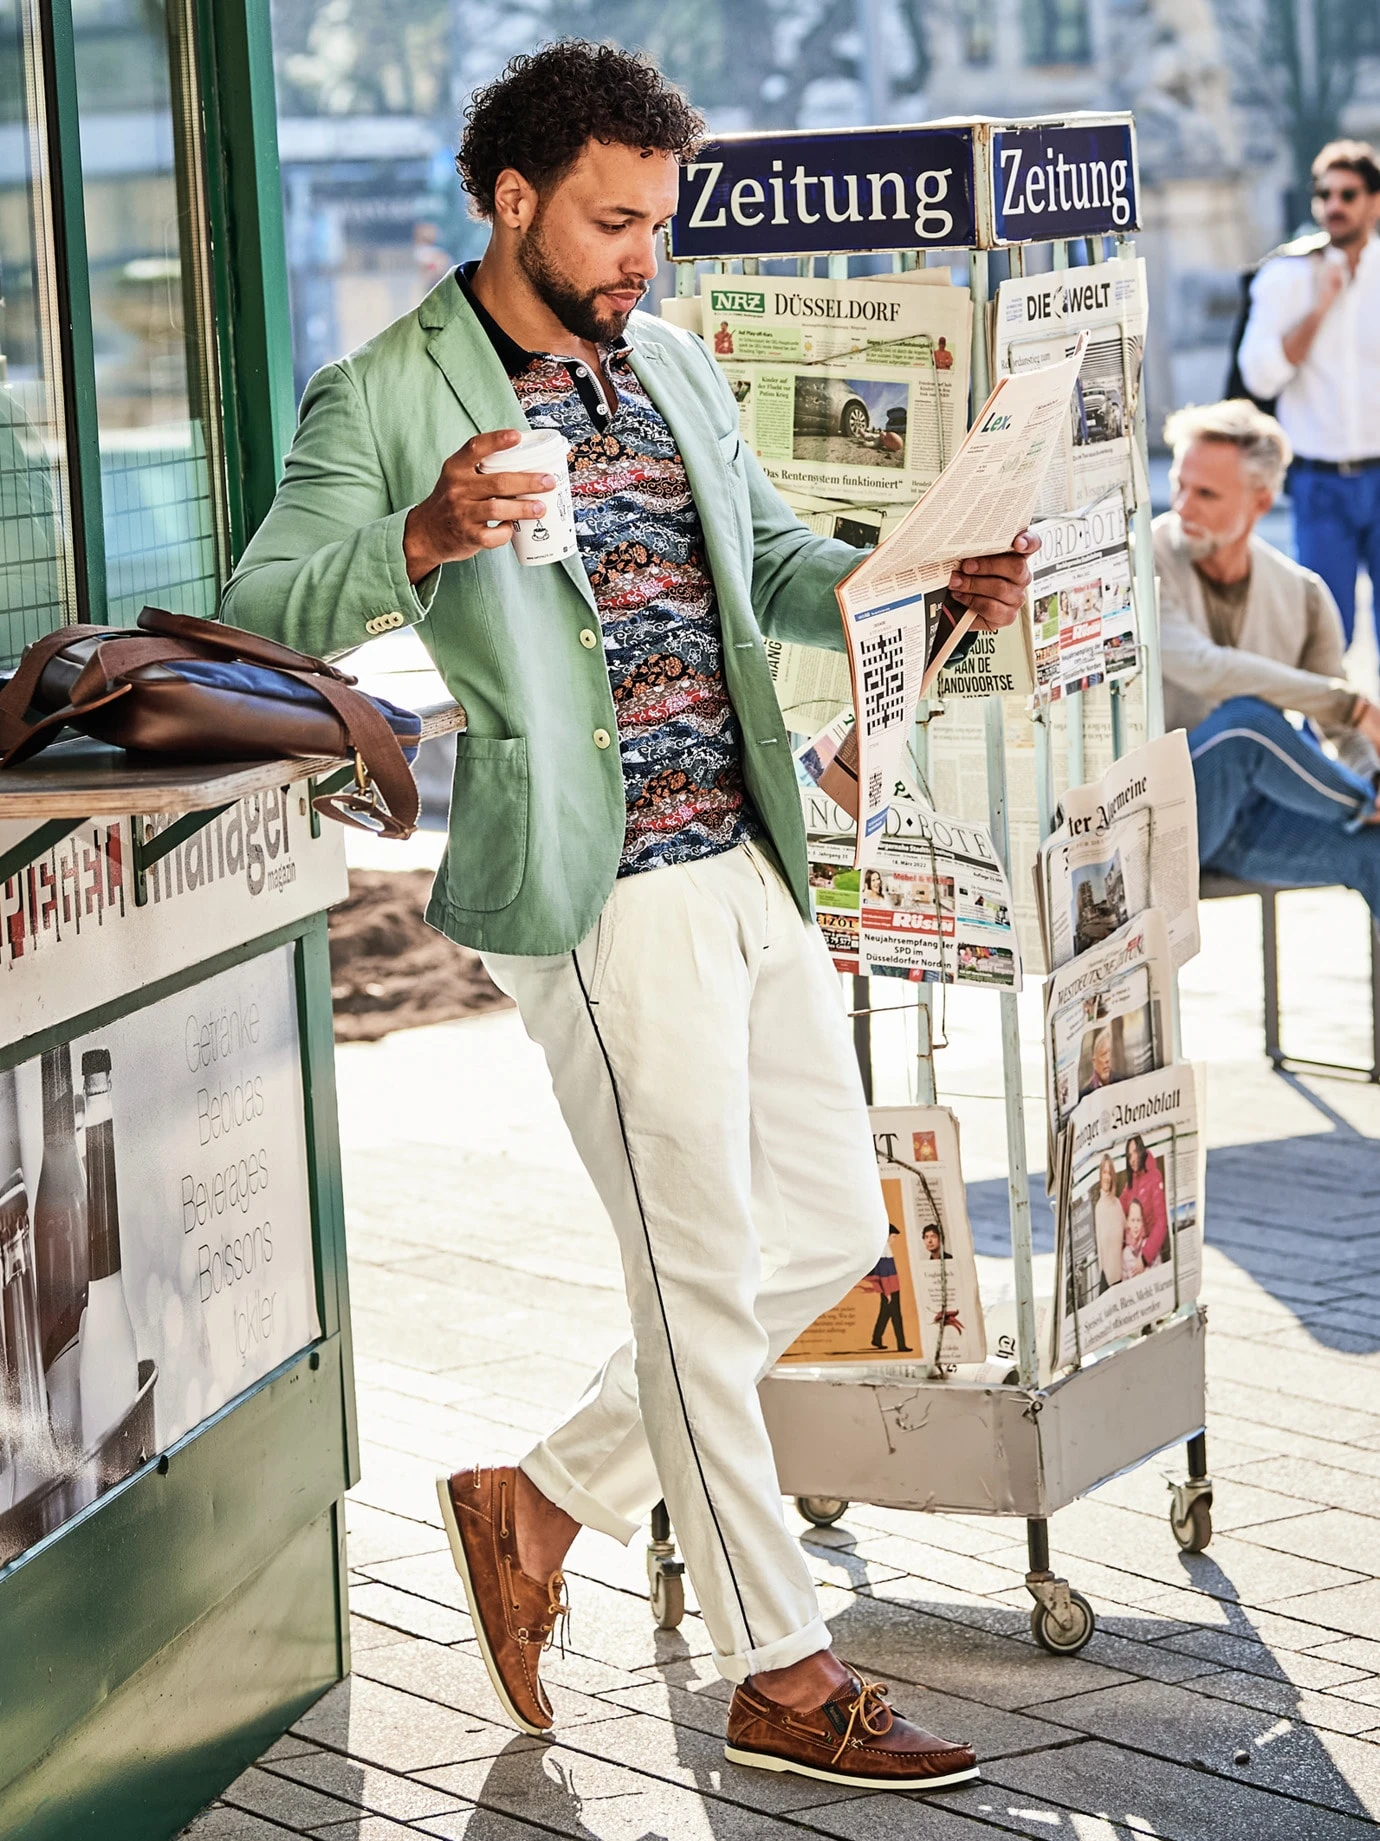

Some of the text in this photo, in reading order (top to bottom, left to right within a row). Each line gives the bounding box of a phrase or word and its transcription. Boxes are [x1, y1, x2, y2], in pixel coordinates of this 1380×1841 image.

[686, 161, 954, 239] Zeitung
[1000, 148, 1131, 225] Zeitung
[713, 291, 901, 322] NRZ DÜSSELDORF
[1026, 292, 1051, 321] DIE
[981, 412, 1012, 433] Lex.
[781, 469, 840, 486] Rentensystem
[842, 475, 904, 491] funktioniert“
[969, 638, 996, 655] ADIJS
[978, 657, 992, 673] DE
[149, 784, 292, 904] manager
[918, 812, 993, 860] BOTE
[267, 857, 298, 893] magazin
[864, 933, 938, 950] Neujahrsempfang
[866, 952, 920, 966] Düsseldorfer
[894, 946, 923, 956] SPD im
[184, 1001, 260, 1074] Getränke
[196, 1070, 264, 1147] Bebidas
[1111, 1088, 1181, 1130] Abendblatt
[181, 1148, 269, 1235] Beverages
[198, 1221, 273, 1303] Boissons
